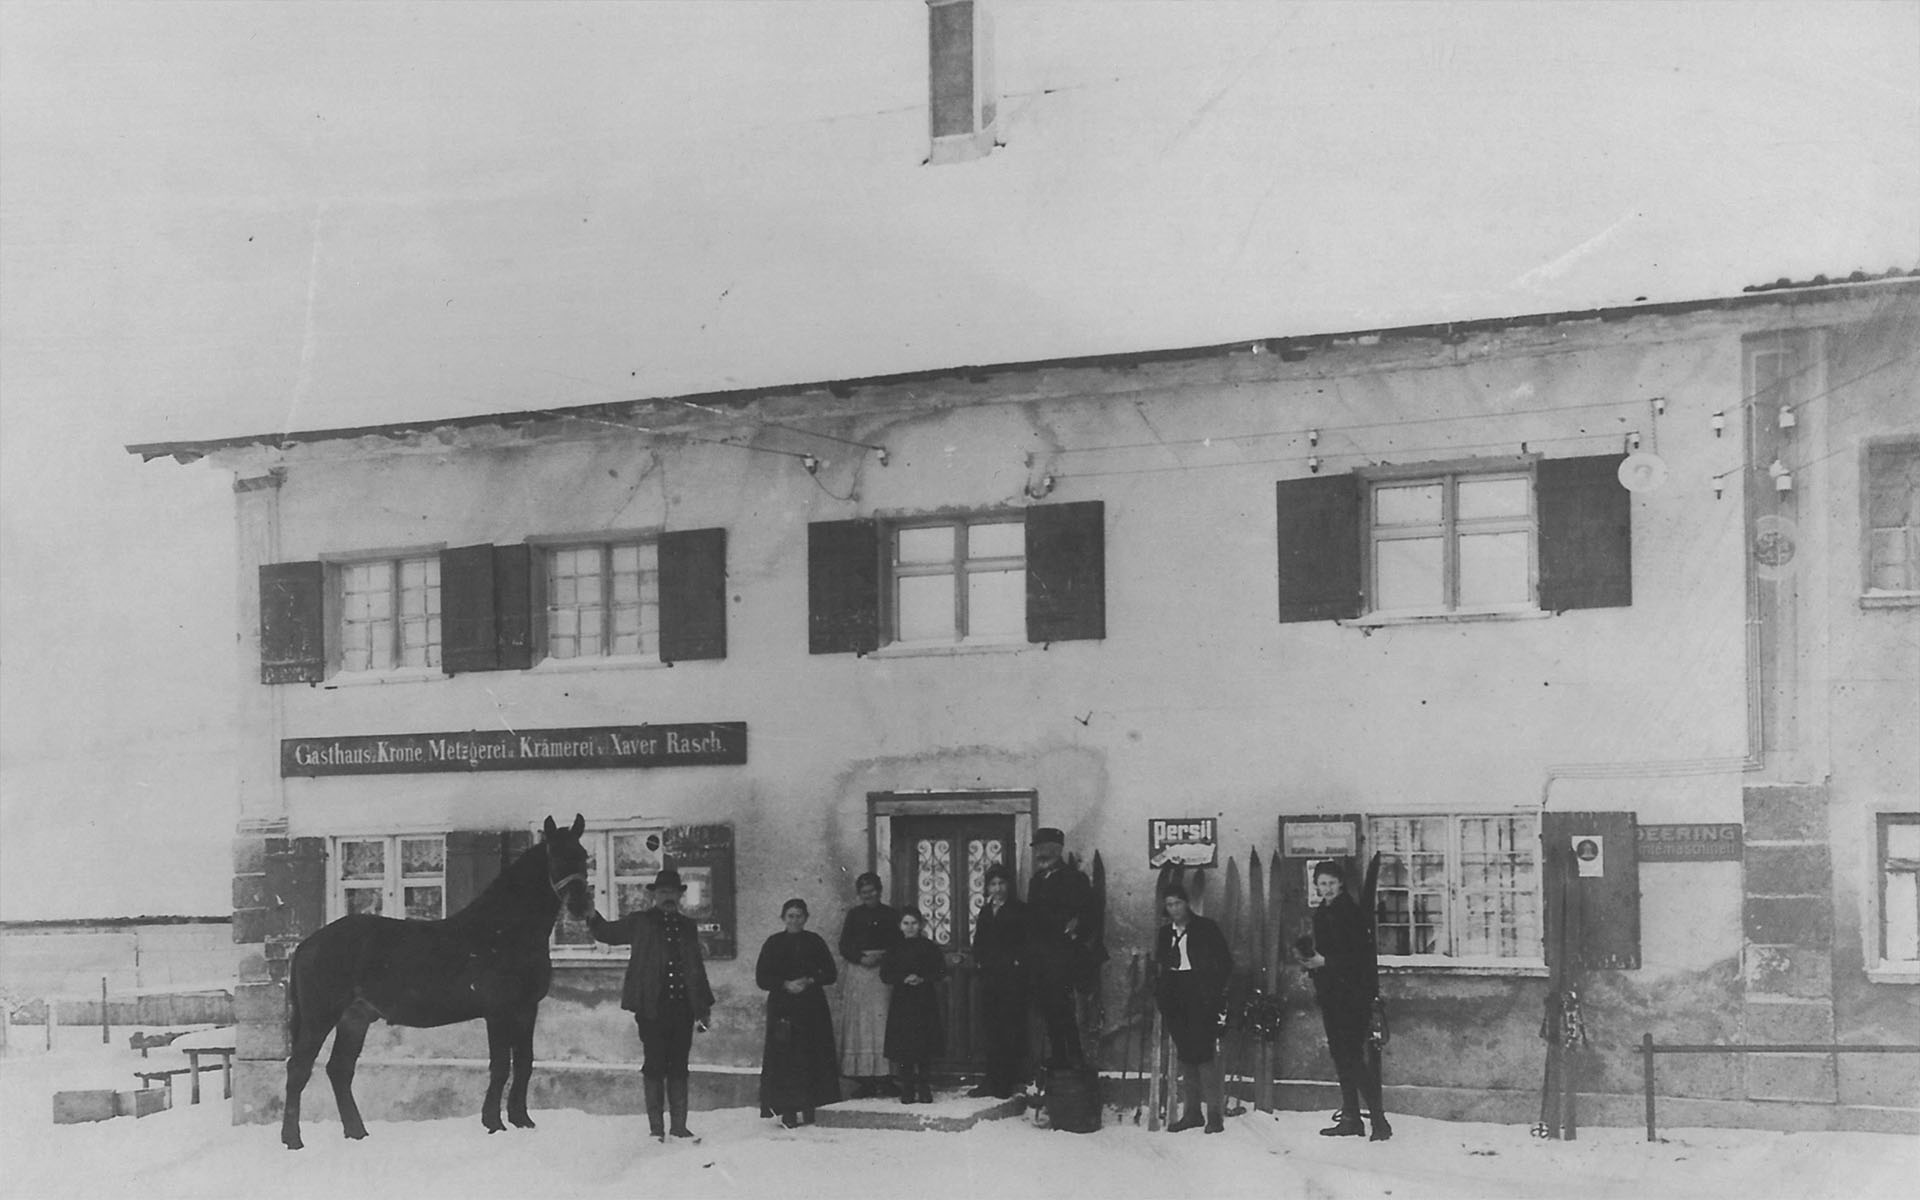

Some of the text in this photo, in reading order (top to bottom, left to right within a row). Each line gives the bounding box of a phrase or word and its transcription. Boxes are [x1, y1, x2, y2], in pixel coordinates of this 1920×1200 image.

[295, 742, 371, 766] Gasthaus
[429, 739, 507, 768] Metzgerei
[520, 736, 594, 759] Krämerei
[610, 733, 657, 756] Xaver
[1153, 820, 1212, 849] Persil
